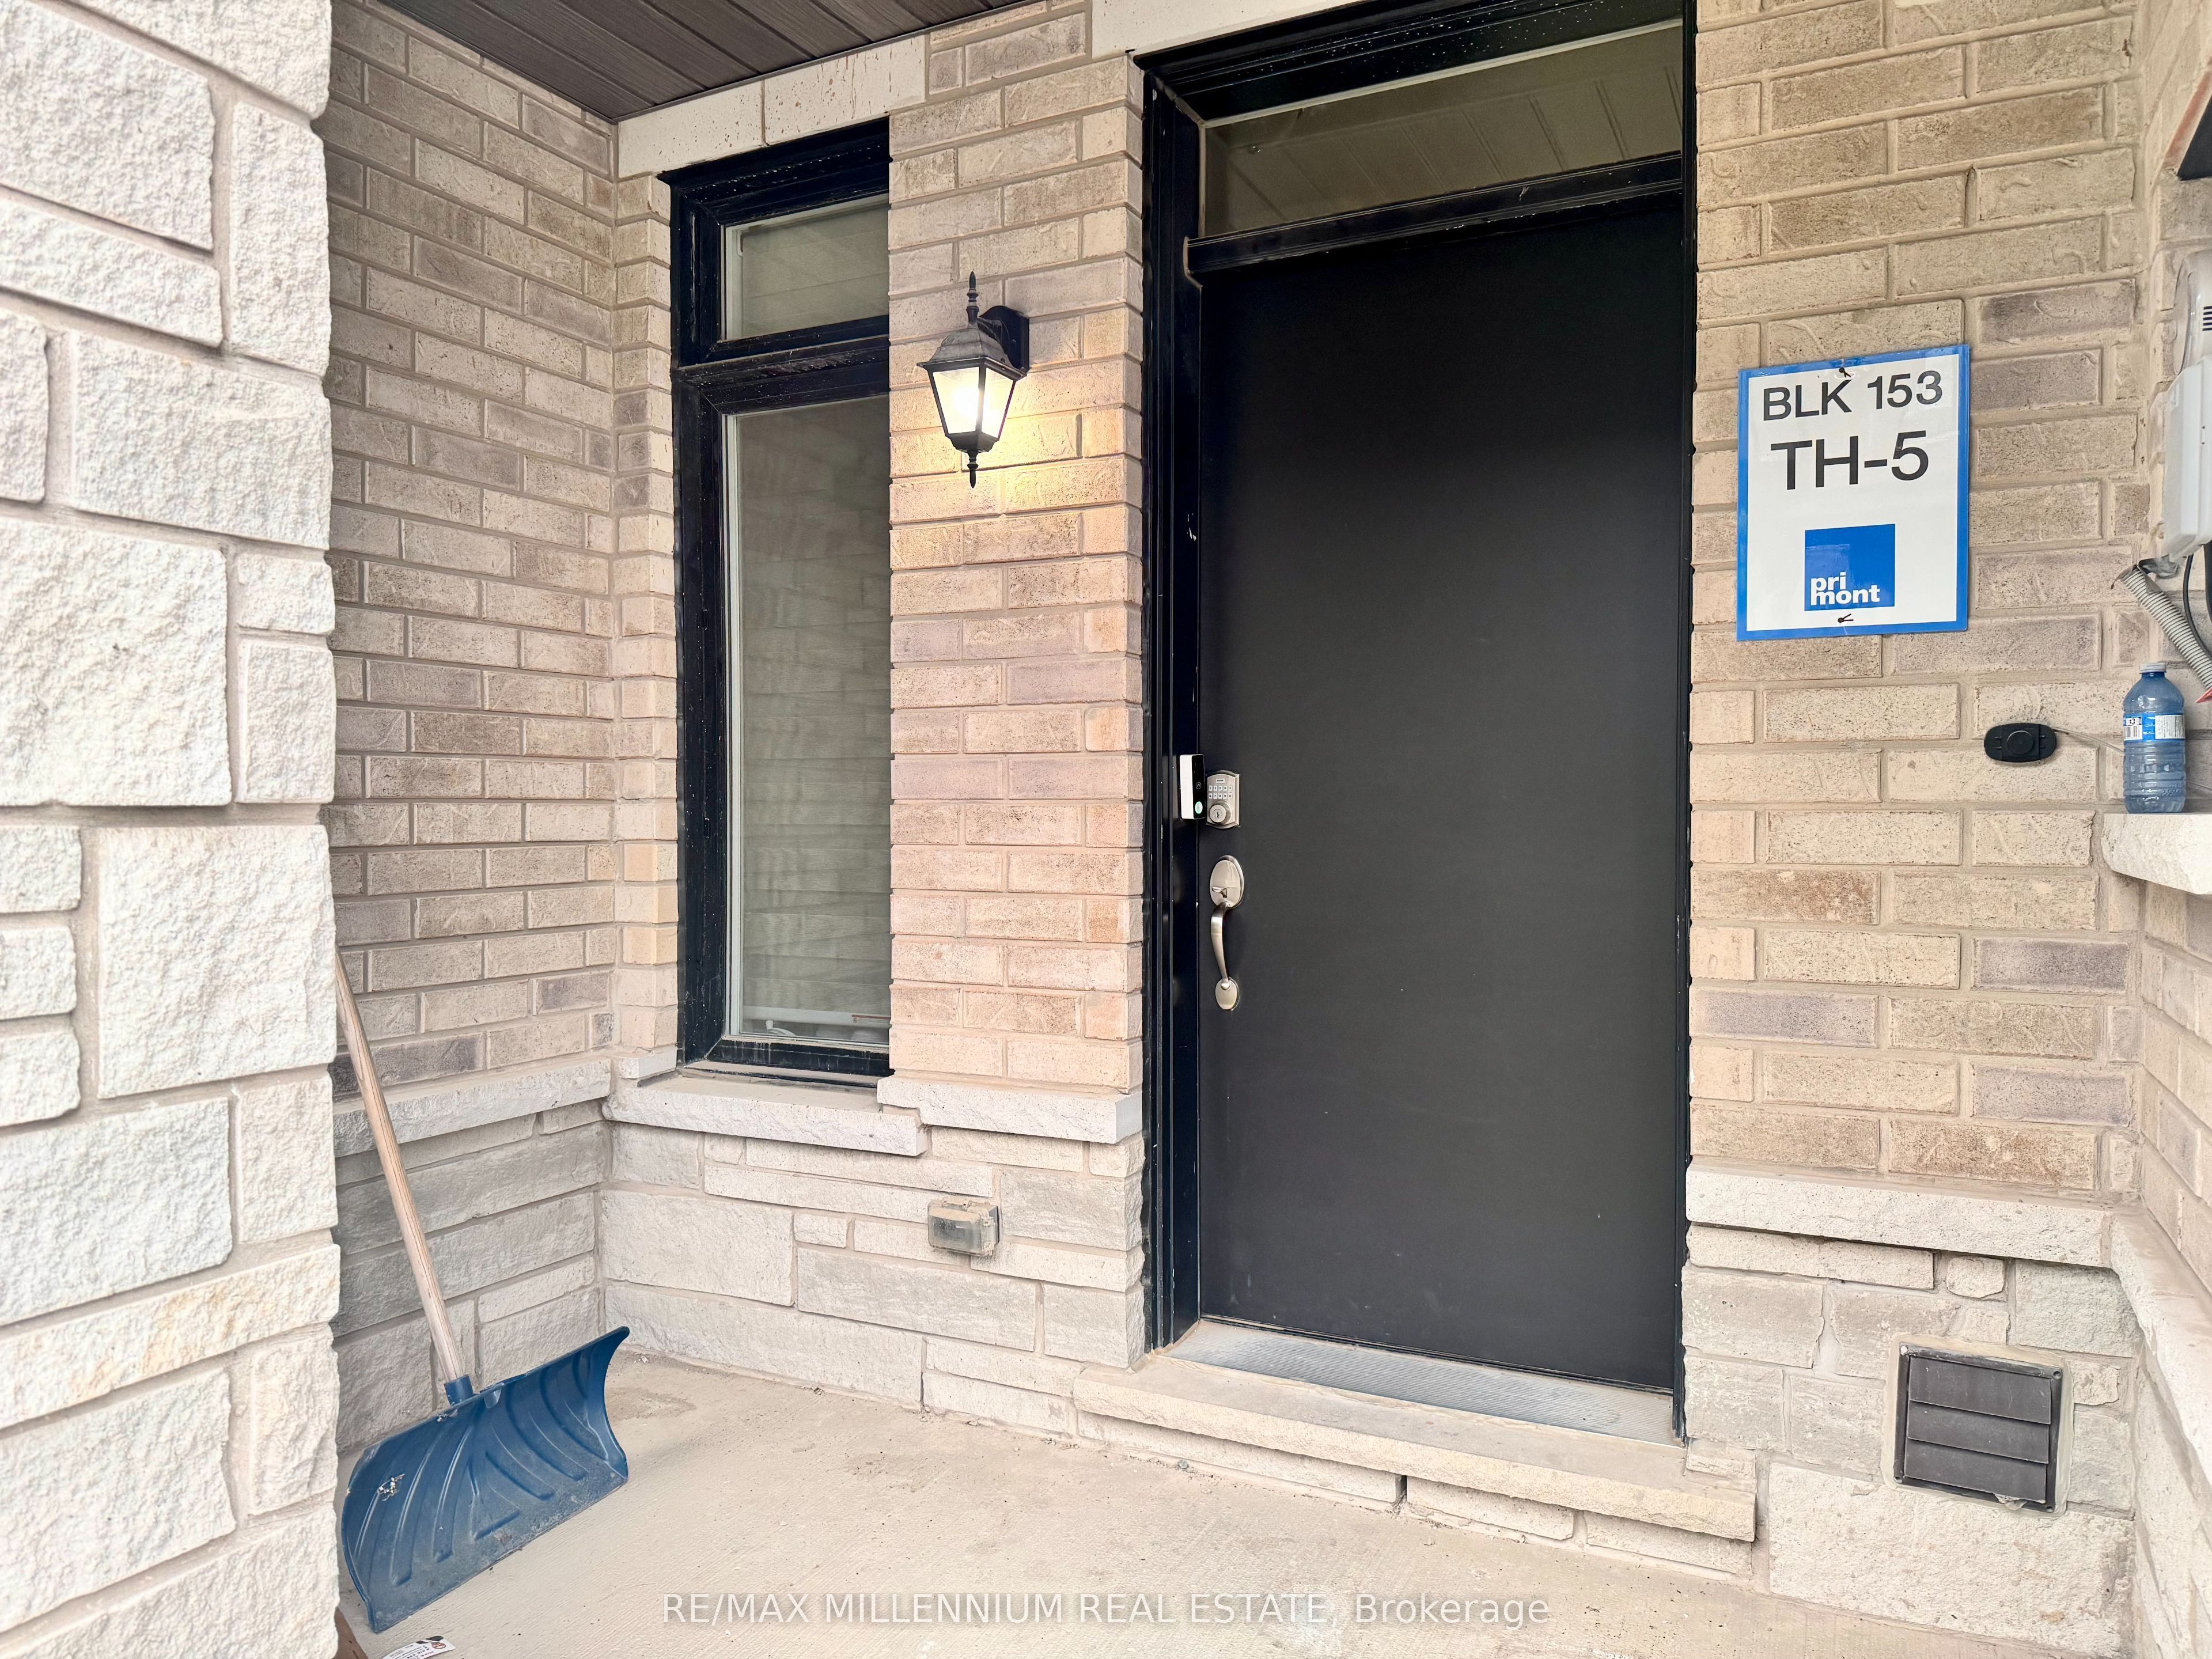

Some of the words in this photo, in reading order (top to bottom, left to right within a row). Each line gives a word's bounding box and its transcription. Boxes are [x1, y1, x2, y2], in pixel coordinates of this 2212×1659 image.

[1763, 379, 1852, 421] BLK
[1868, 370, 1942, 410] 153
[1770, 430, 1929, 490] TH-5
[1810, 571, 1846, 593] pri
[1810, 585, 1880, 605] mont
